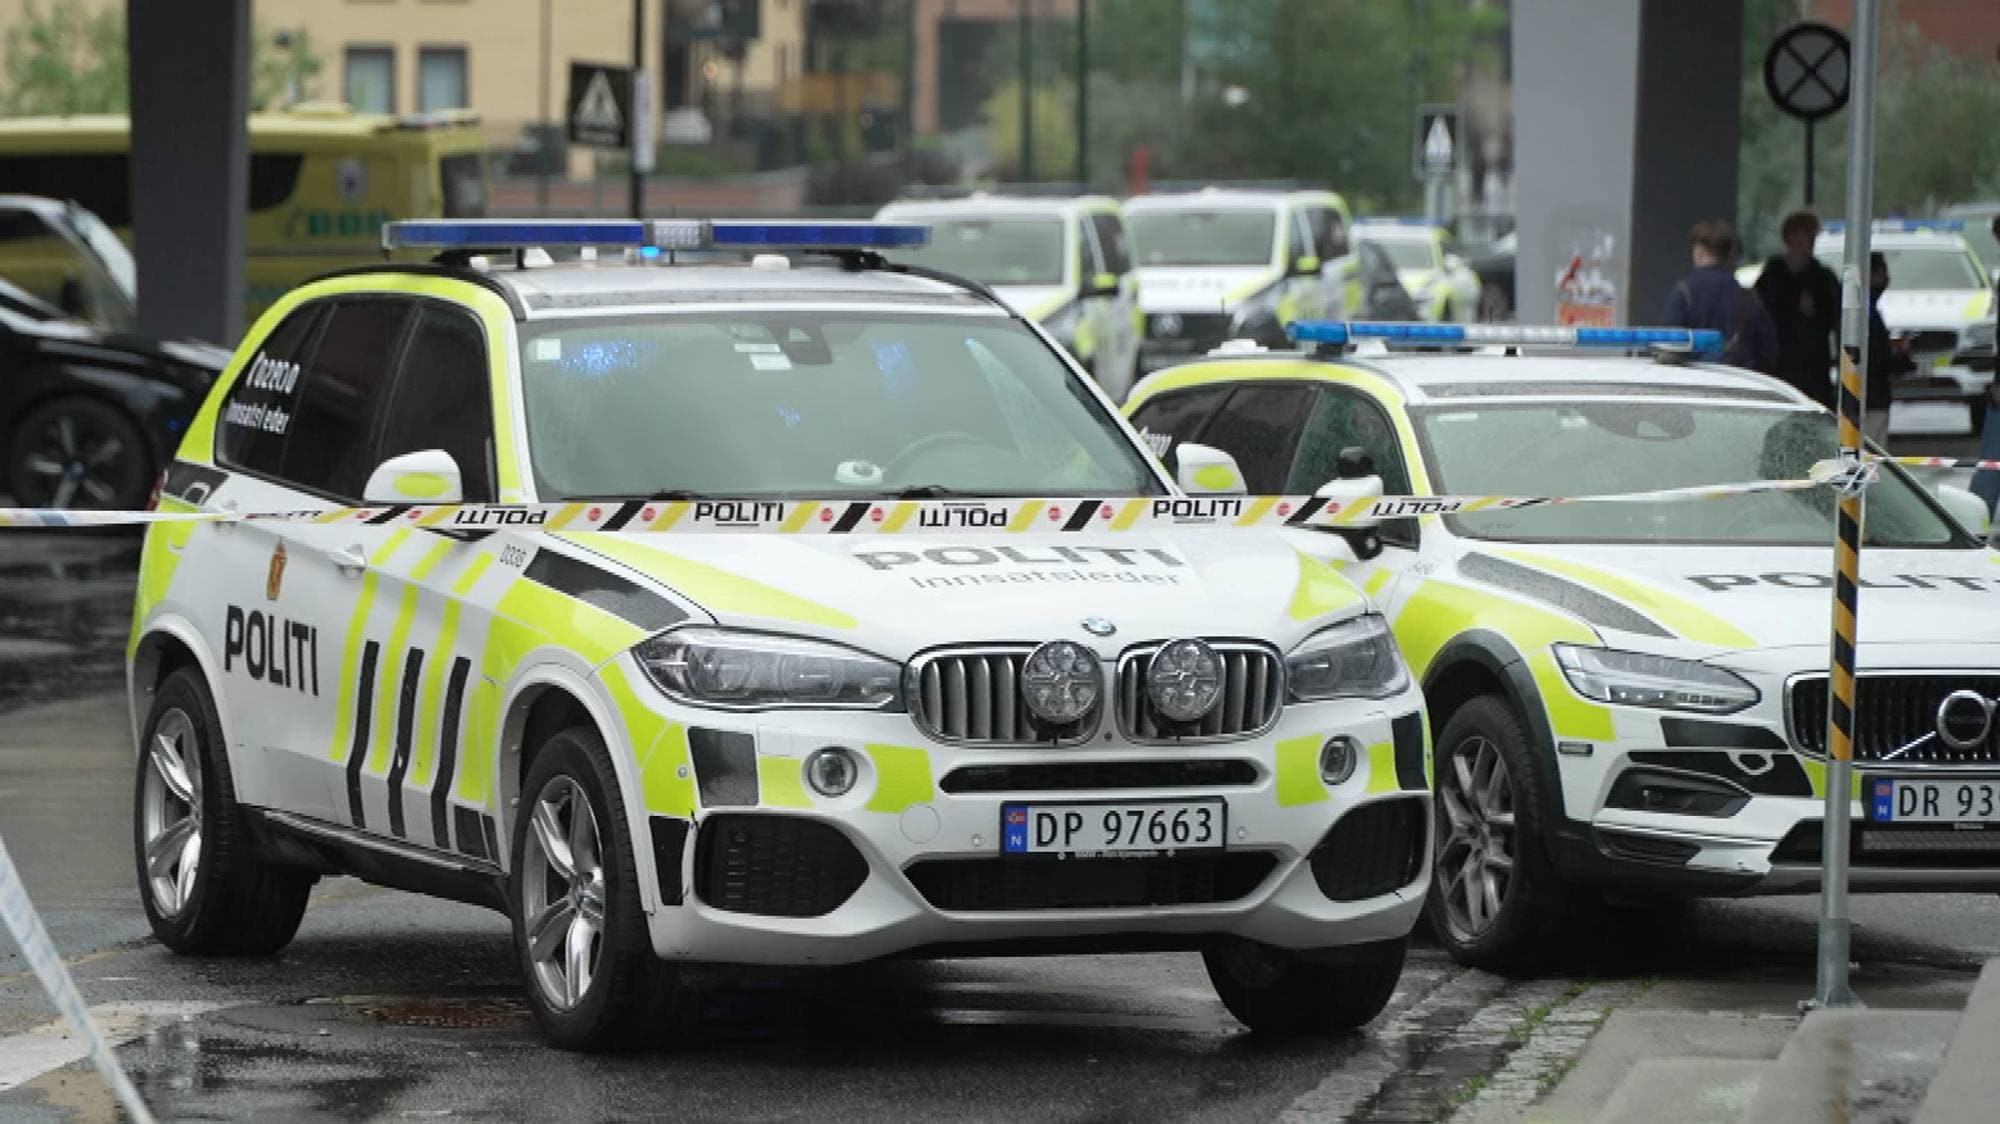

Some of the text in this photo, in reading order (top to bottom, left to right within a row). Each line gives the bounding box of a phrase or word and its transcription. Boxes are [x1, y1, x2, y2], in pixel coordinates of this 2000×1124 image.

[454, 509, 548, 524] POLITI
[694, 502, 784, 521] POLITI
[920, 507, 1008, 527] POLITI
[1153, 499, 1241, 518] POLITI
[1372, 502, 1462, 516] POLITI
[854, 546, 1184, 570] POLITI
[1687, 572, 2000, 592] POLIT
[224, 603, 319, 697] POLITI
[1900, 784, 2000, 817] DR 93
[1036, 807, 1212, 847] DP 97663
[1011, 835, 1022, 846] N
